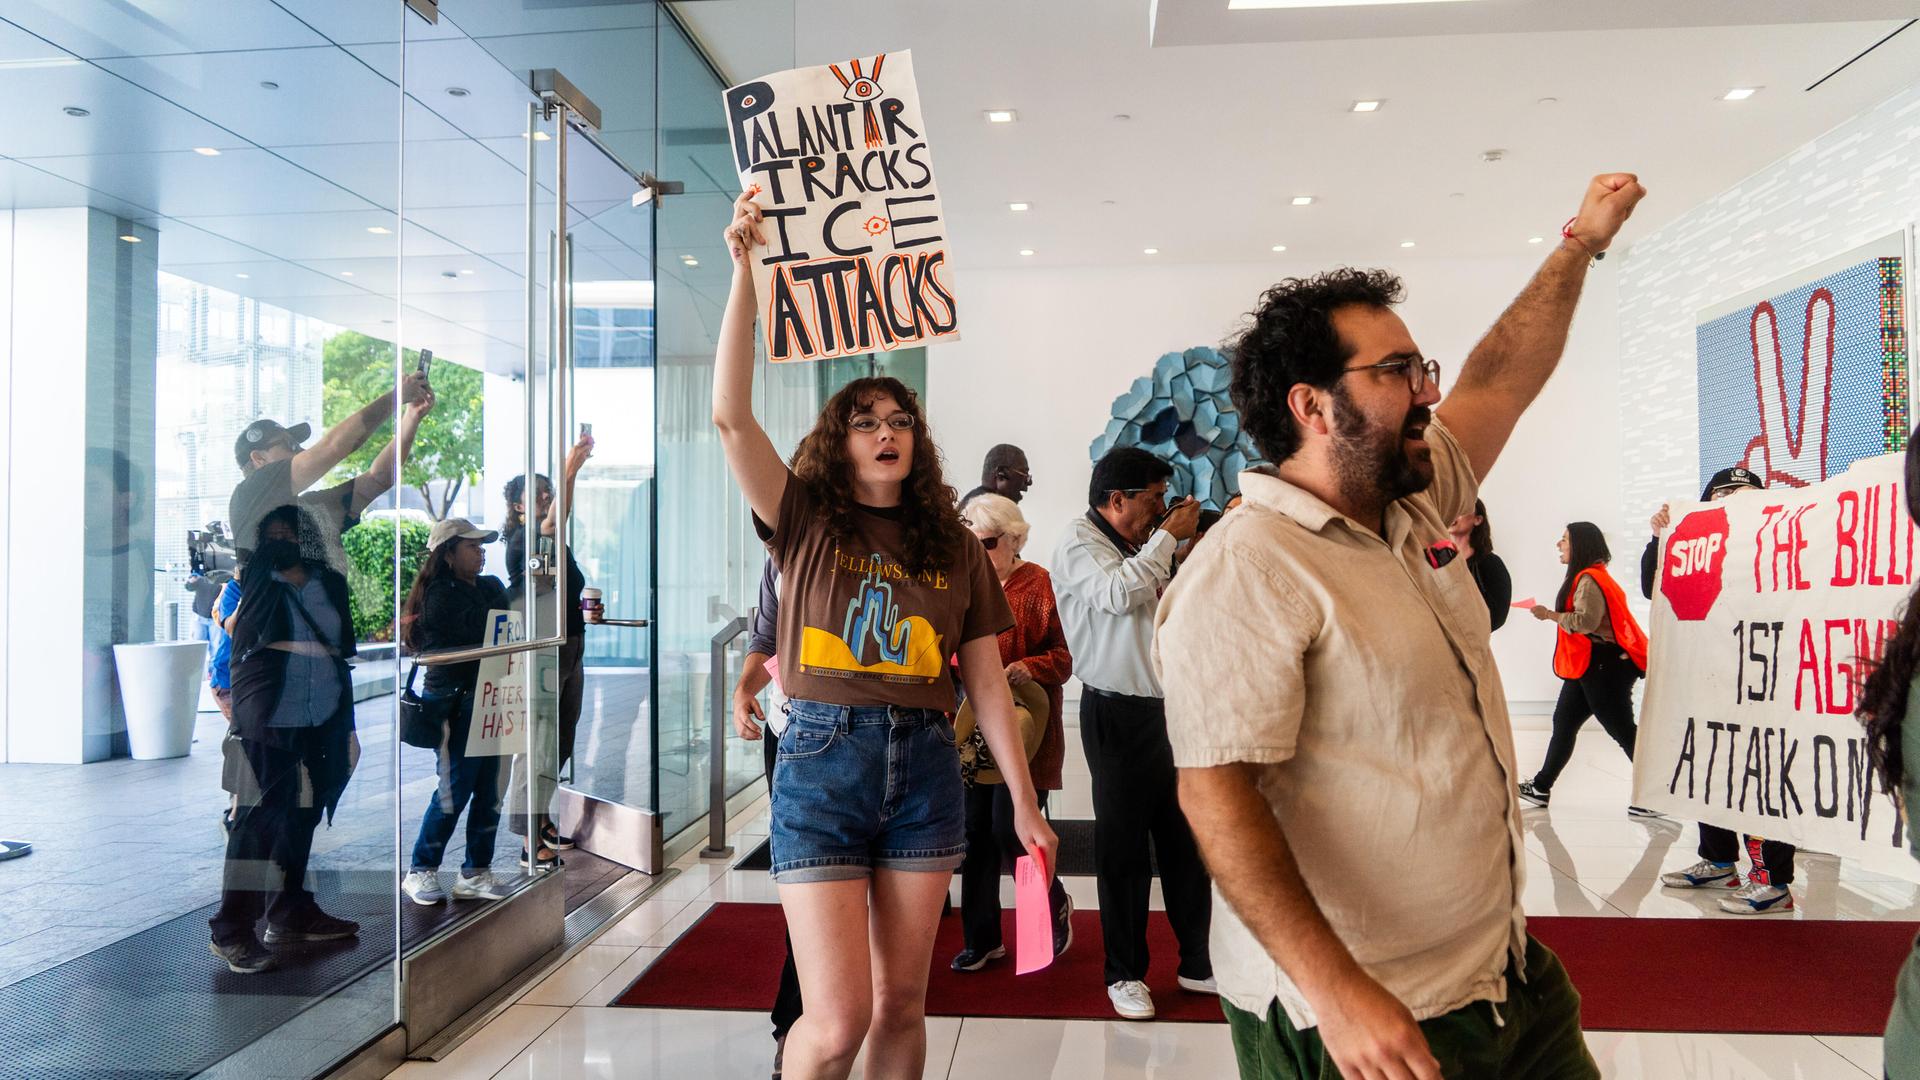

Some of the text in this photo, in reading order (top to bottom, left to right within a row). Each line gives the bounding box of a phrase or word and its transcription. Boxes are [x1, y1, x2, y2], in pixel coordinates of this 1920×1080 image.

[727, 80, 918, 172] PALANTIR
[751, 143, 931, 204] TRACKS
[761, 194, 942, 265] ICE
[769, 251, 957, 359] ATTACKS
[1671, 532, 1721, 577] STOP
[1755, 503, 1817, 593] THE
[482, 681, 523, 708] PETER
[1733, 620, 1784, 704] 1ST
[1669, 717, 1803, 819] ATTACK
